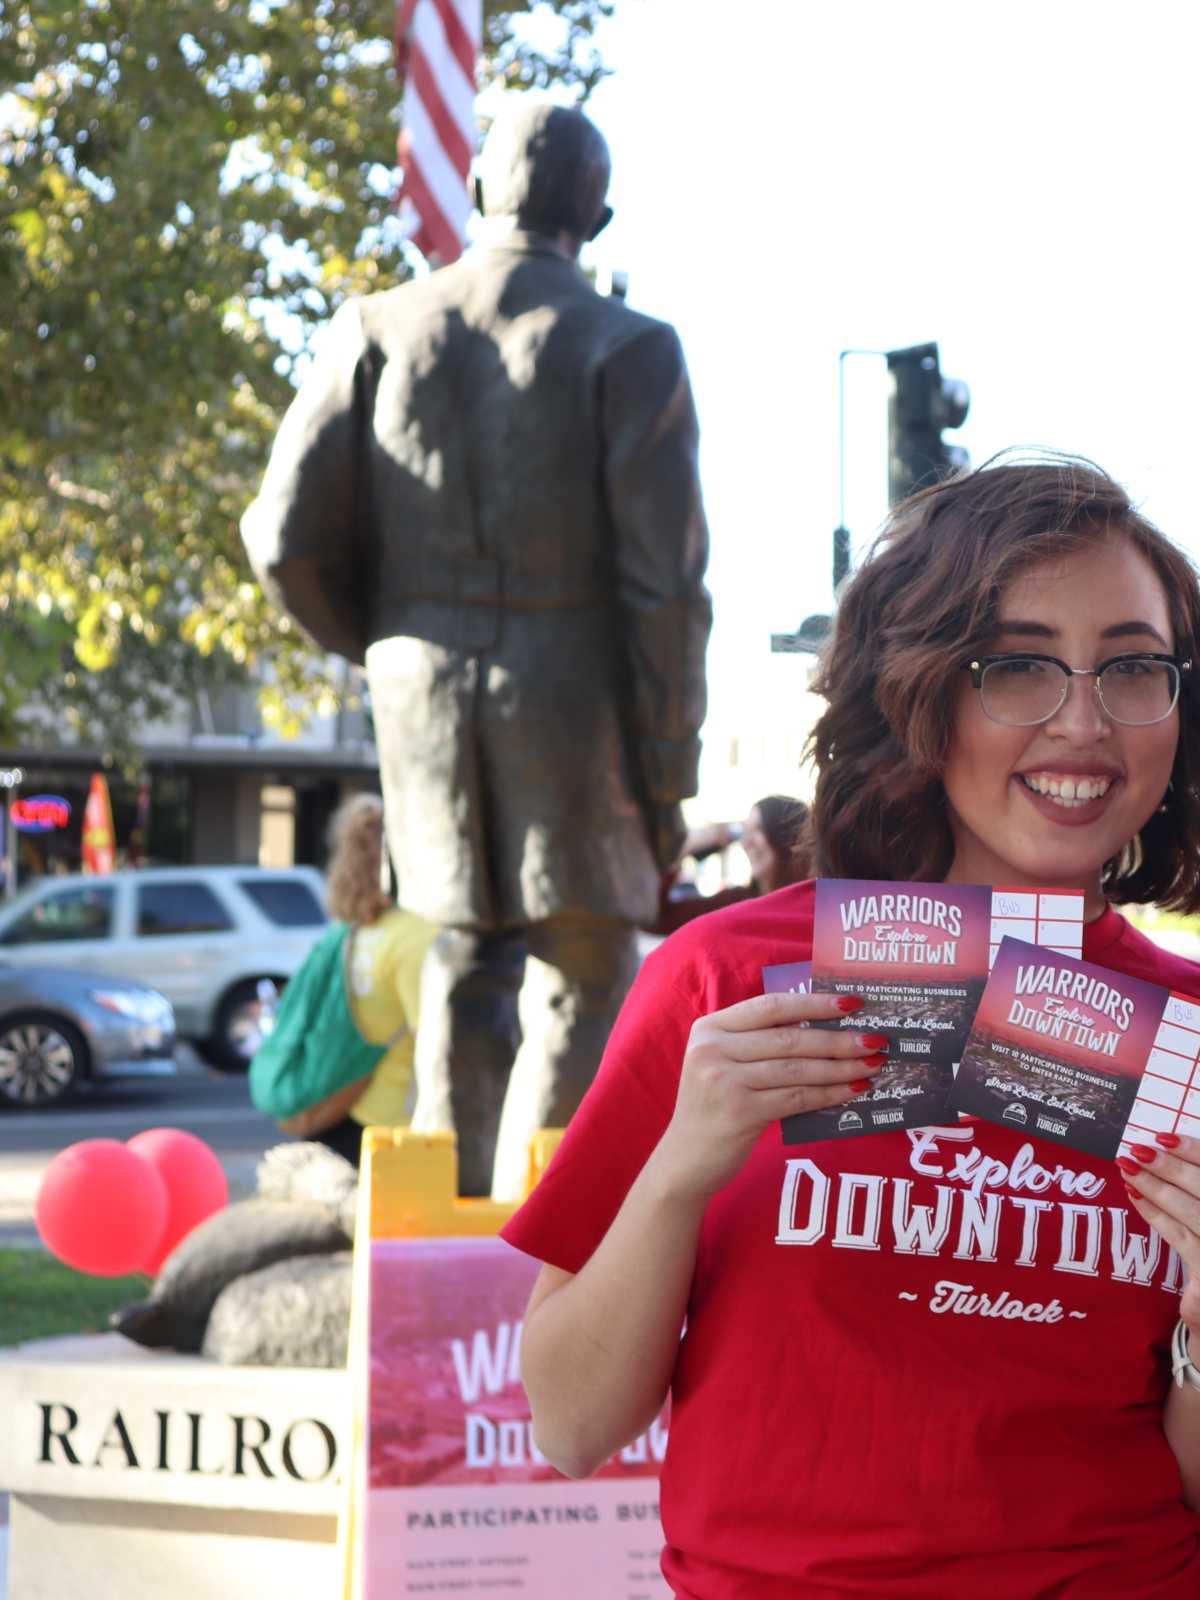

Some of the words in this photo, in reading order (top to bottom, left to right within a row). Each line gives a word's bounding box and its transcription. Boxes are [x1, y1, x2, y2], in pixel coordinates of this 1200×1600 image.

[840, 894, 962, 937] WARRIORS
[874, 925, 928, 944] Explore
[843, 936, 957, 965] DOWNTOWN
[835, 984, 854, 992] VISIT
[857, 985, 865, 993] 10
[866, 985, 922, 995] PARTICIPATING
[924, 987, 968, 997] BUSINESSES
[1015, 965, 1135, 1032] WARRIORS
[840, 1015, 866, 1028] Shop
[868, 1016, 902, 1029] Local.
[903, 1016, 923, 1029] Eat
[922, 1018, 956, 1030] Local.
[1044, 997, 1096, 1028] Explore
[1007, 1000, 1121, 1057] DOWNTOWN
[900, 1042, 931, 1054] TURLOCK
[991, 1043, 1010, 1055] VISIT
[1011, 1050, 1019, 1058] 10
[1020, 1052, 1074, 1077] PARTICIPATING
[1075, 1071, 1118, 1091] BUSINESSES
[1020, 1061, 1030, 1070] TO
[1031, 1065, 1053, 1079] ENTER
[1053, 1073, 1079, 1087] RAFFLE
[873, 1088, 893, 1101] Eat
[891, 1085, 925, 1100] Local.
[985, 1076, 1013, 1093] Shop
[1012, 1084, 1045, 1103] Local.
[1046, 1096, 1065, 1109] Eat
[1064, 1102, 1097, 1121] Local.
[871, 1111, 904, 1125] TURLOCK
[1036, 1117, 1069, 1137] TURLOCK
[906, 1126, 1106, 1200] Explore
[36, 1400, 342, 1486] RAILRO
[406, 1504, 600, 1529] PARTICIPATING
